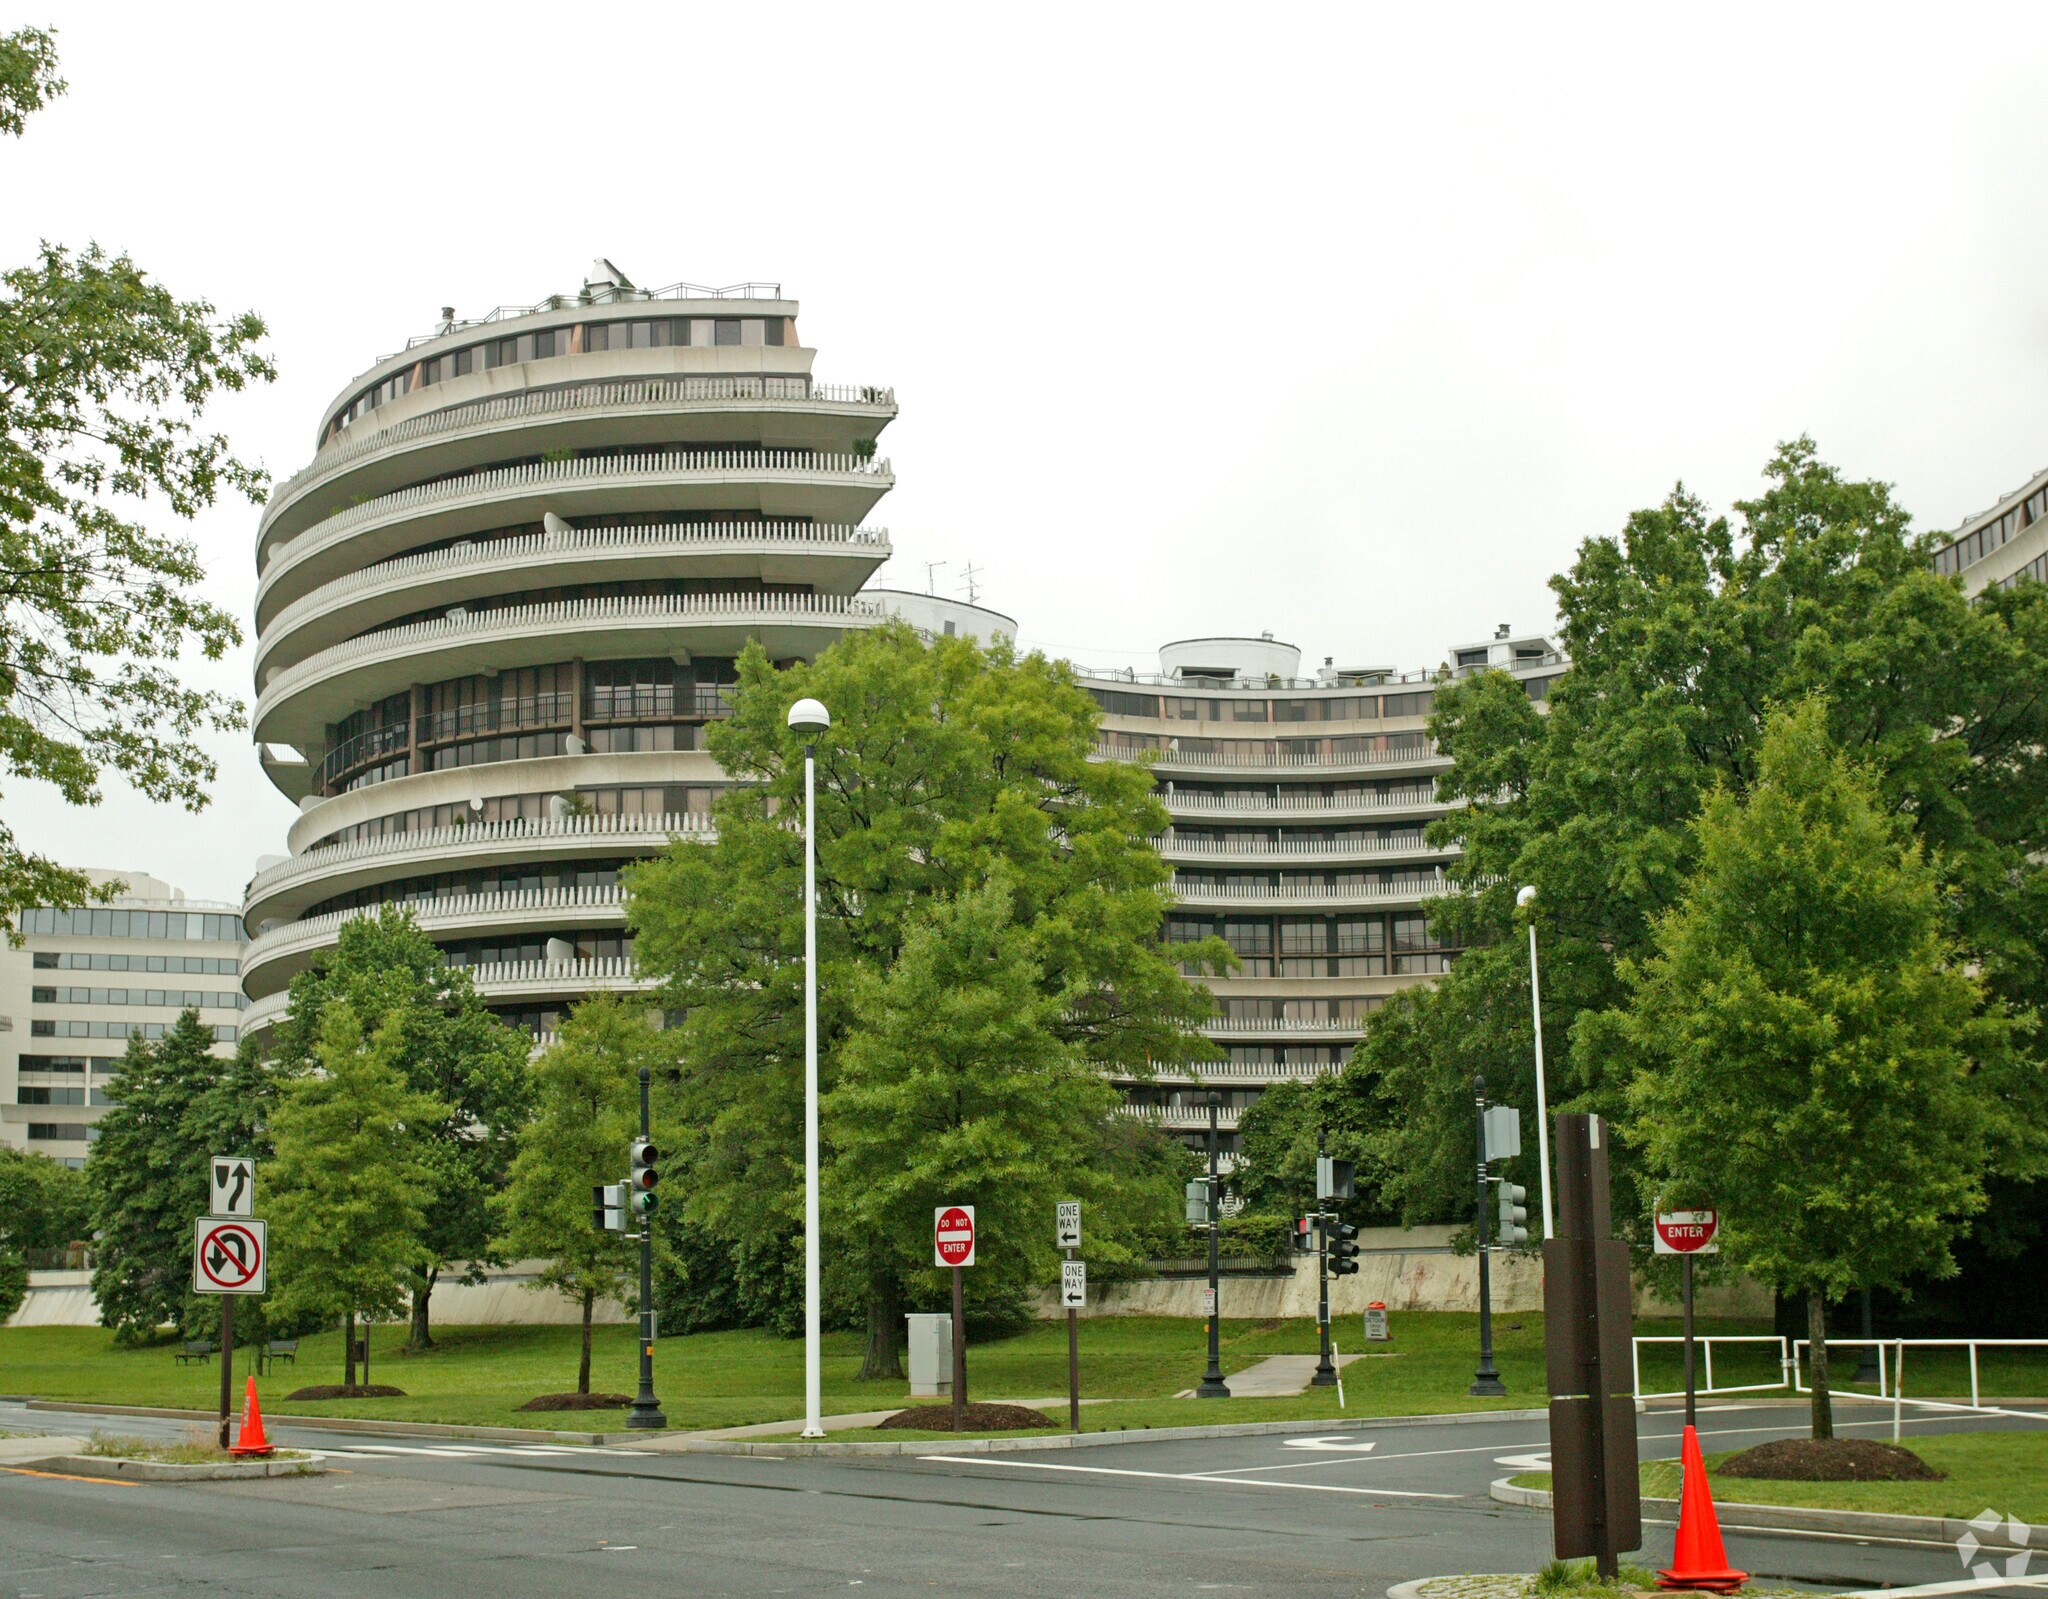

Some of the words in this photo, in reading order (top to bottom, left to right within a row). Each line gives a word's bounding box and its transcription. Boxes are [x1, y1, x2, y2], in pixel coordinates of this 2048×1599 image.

[1060, 1205, 1077, 1217] ONE
[941, 1219, 950, 1228] DO
[956, 1218, 968, 1227] NOT
[1059, 1218, 1078, 1229] WAY
[1668, 1226, 1703, 1238] ENTER
[944, 1243, 966, 1253] ENTER
[1065, 1265, 1083, 1277] ONE
[1064, 1278, 1083, 1289] WAY
